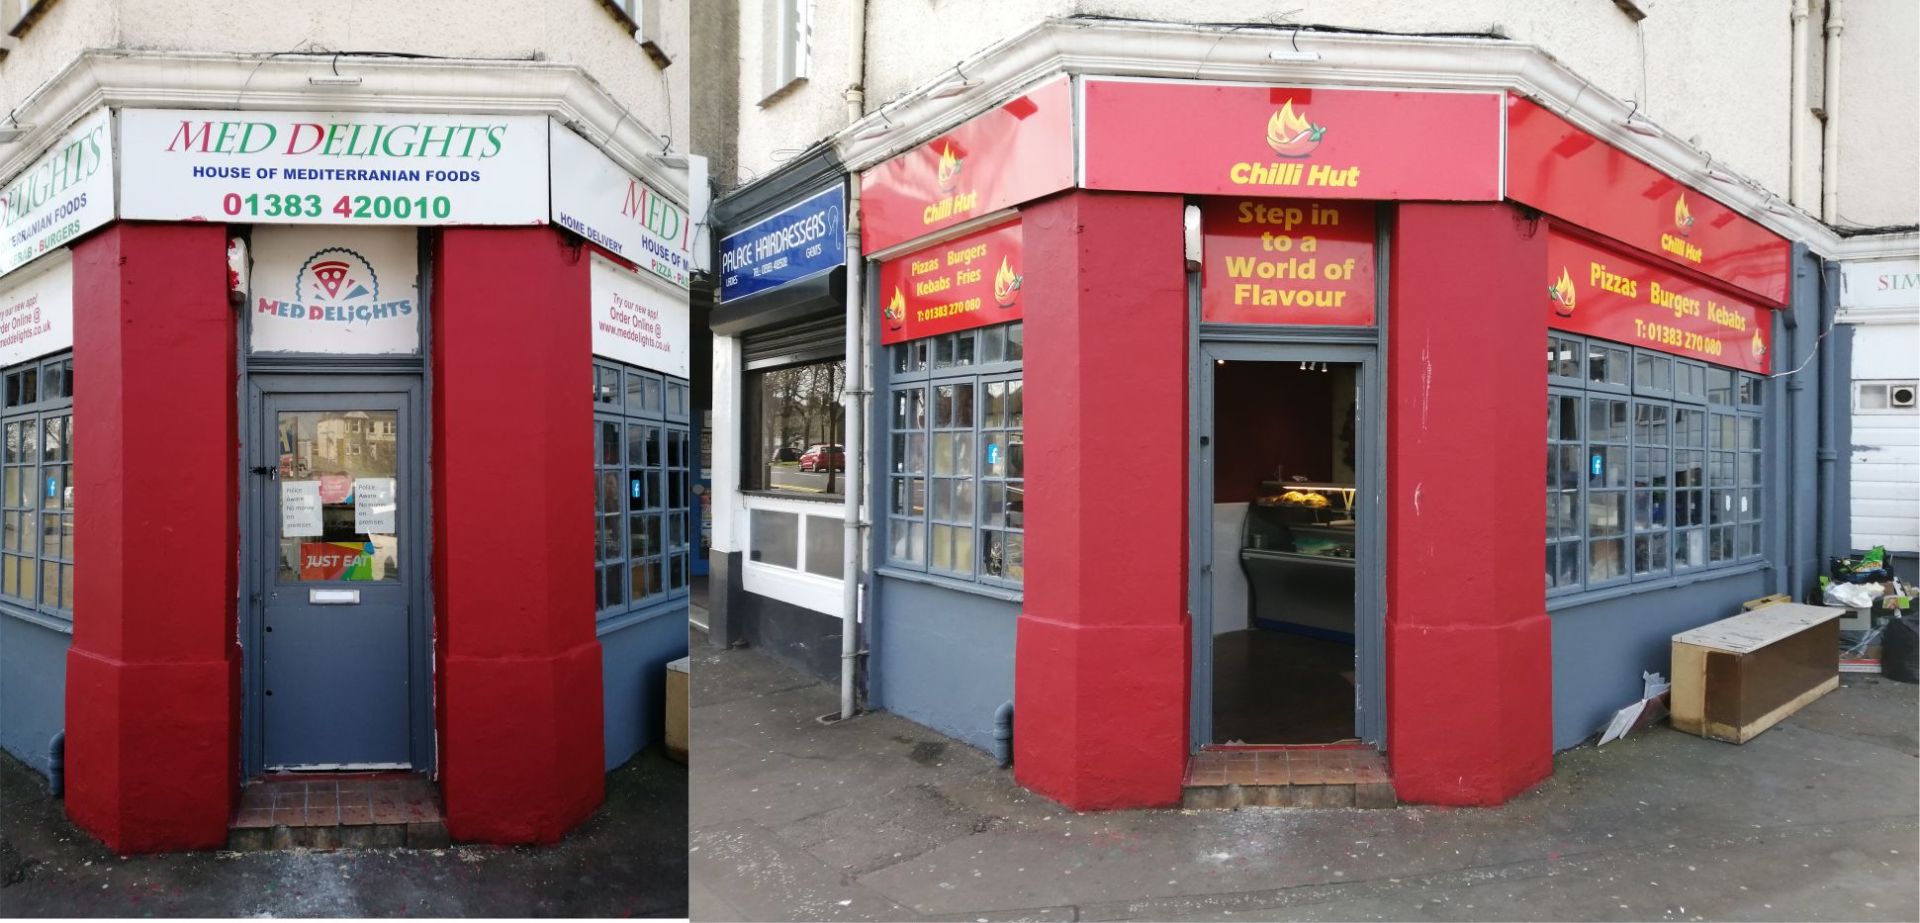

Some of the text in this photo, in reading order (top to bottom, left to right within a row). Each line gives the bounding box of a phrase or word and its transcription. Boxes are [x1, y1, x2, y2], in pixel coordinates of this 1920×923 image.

[165, 120, 507, 161] MED DELIGHTS
[193, 166, 481, 182] HOUSE OF MEDITERRANIAN FOODS
[1230, 162, 1360, 187] Chilli Hut
[54, 192, 88, 223] FOODS
[223, 193, 451, 219] 01383 420010
[621, 178, 679, 241] MED
[923, 189, 977, 225] Chilli Hut
[1238, 201, 1339, 231] Step in
[39, 219, 80, 253] BURGERS
[560, 211, 623, 254] HOME DELIVERY
[722, 242, 753, 275] PALACE
[755, 211, 826, 262] HAIRDRESSERS
[1261, 232, 1317, 252] to a
[642, 234, 670, 261] HOUSE
[671, 252, 681, 266] OF
[911, 243, 988, 277] Pizzas Burgers
[1661, 233, 1702, 264] Chilli Hut
[651, 258, 672, 279] PIZZA
[916, 268, 982, 297] Kebabs Fries
[1225, 256, 1356, 280] World of
[258, 297, 305, 319] MED
[613, 292, 623, 308] Try
[624, 299, 634, 309] our
[635, 304, 647, 314] new
[924, 305, 948, 321] 01383
[949, 302, 964, 316] 270
[964, 297, 981, 312] 080
[1234, 283, 1346, 307] Flavour
[1590, 262, 1746, 332] Pizzas Burgers Kebabs
[11, 312, 32, 330] Online
[610, 306, 631, 325] Order
[632, 314, 653, 333] Online
[599, 320, 670, 352] www.meddelights.co.uk
[1635, 319, 1722, 356] T: 01383 270 080
[306, 555, 370, 569] JUST EAT
